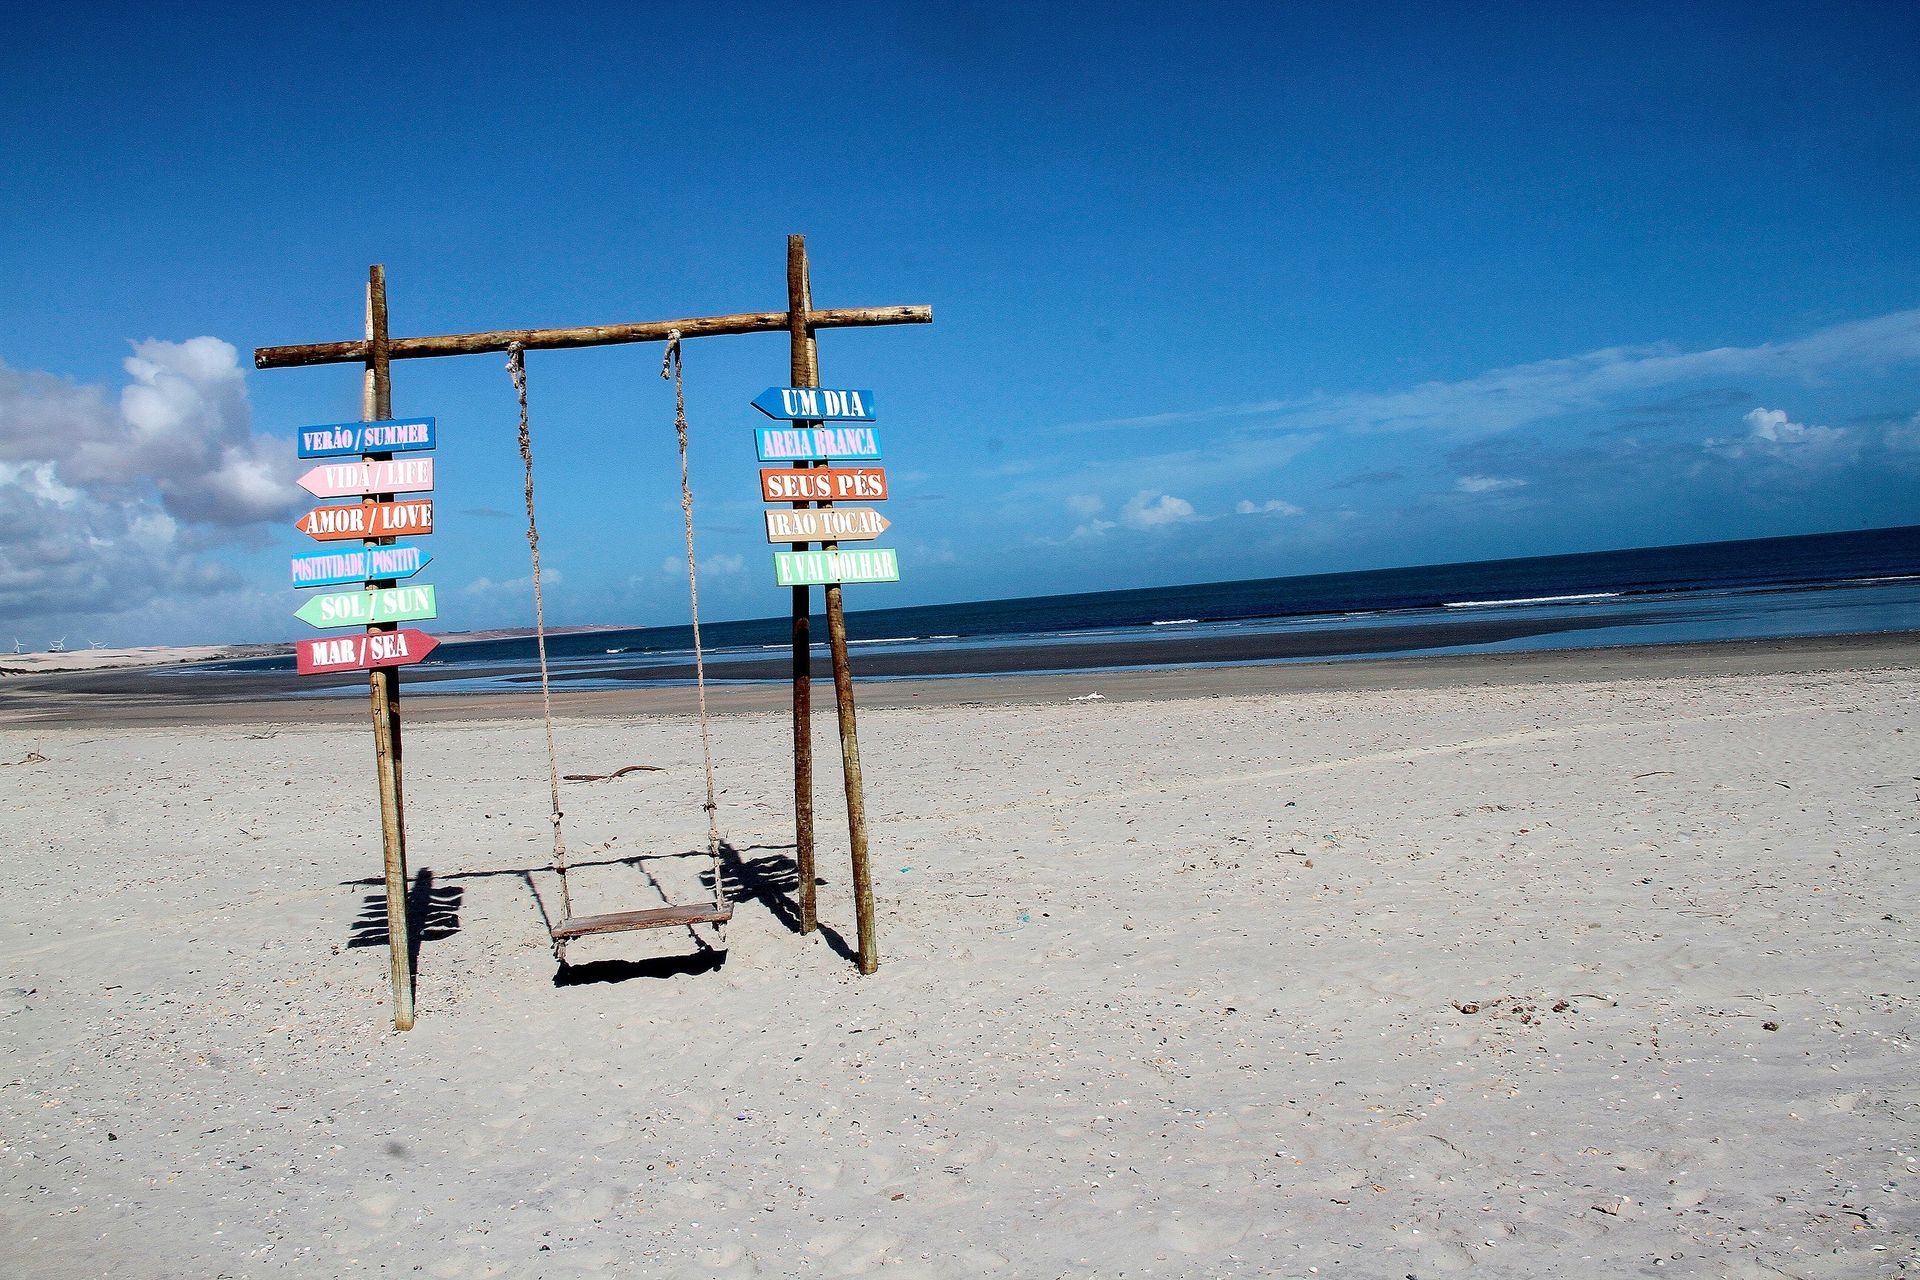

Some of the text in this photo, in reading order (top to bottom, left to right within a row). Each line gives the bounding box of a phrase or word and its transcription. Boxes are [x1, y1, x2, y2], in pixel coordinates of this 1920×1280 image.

[781, 389, 866, 417] UM DIA
[303, 426, 353, 451] VERÃO
[364, 424, 429, 447] SUMMER
[764, 428, 877, 457] AREIA BRANCA
[325, 464, 370, 489] VIDA
[387, 461, 428, 485] LIFE
[767, 469, 883, 498] SEUS PÉS
[305, 508, 364, 534] AMOR
[382, 504, 432, 529] LOVE
[767, 509, 885, 536] IRÃO TOCAR
[291, 552, 365, 582] POSITIVIDADE
[780, 551, 895, 582] E VAI MOLHAR
[320, 594, 365, 621] SOL
[383, 588, 430, 614] SUN
[311, 639, 356, 666] MAR
[370, 634, 409, 660] SEA
